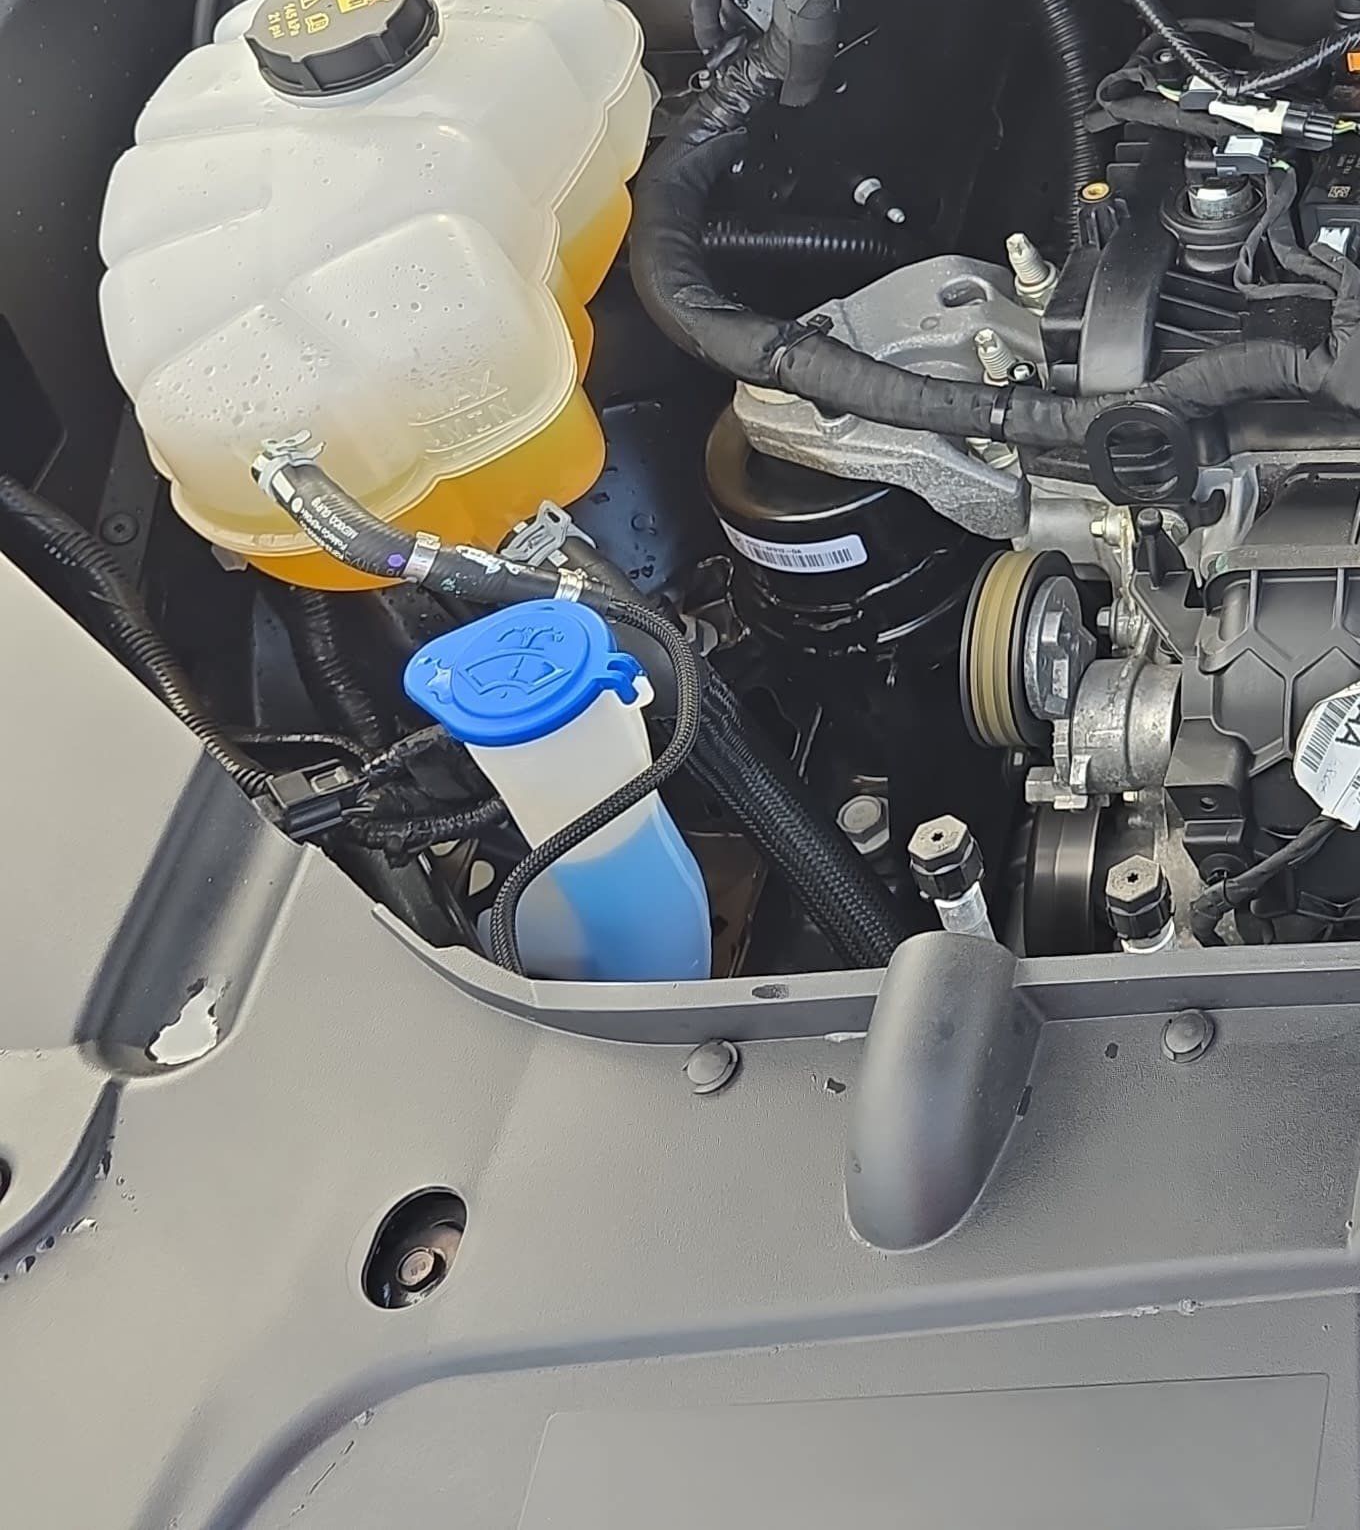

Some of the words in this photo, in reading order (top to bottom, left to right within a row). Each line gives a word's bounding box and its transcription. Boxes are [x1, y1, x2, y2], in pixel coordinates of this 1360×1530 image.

[267, 11, 281, 24] 21
[268, 24, 285, 39] psi
[287, 18, 301, 37] kPa
